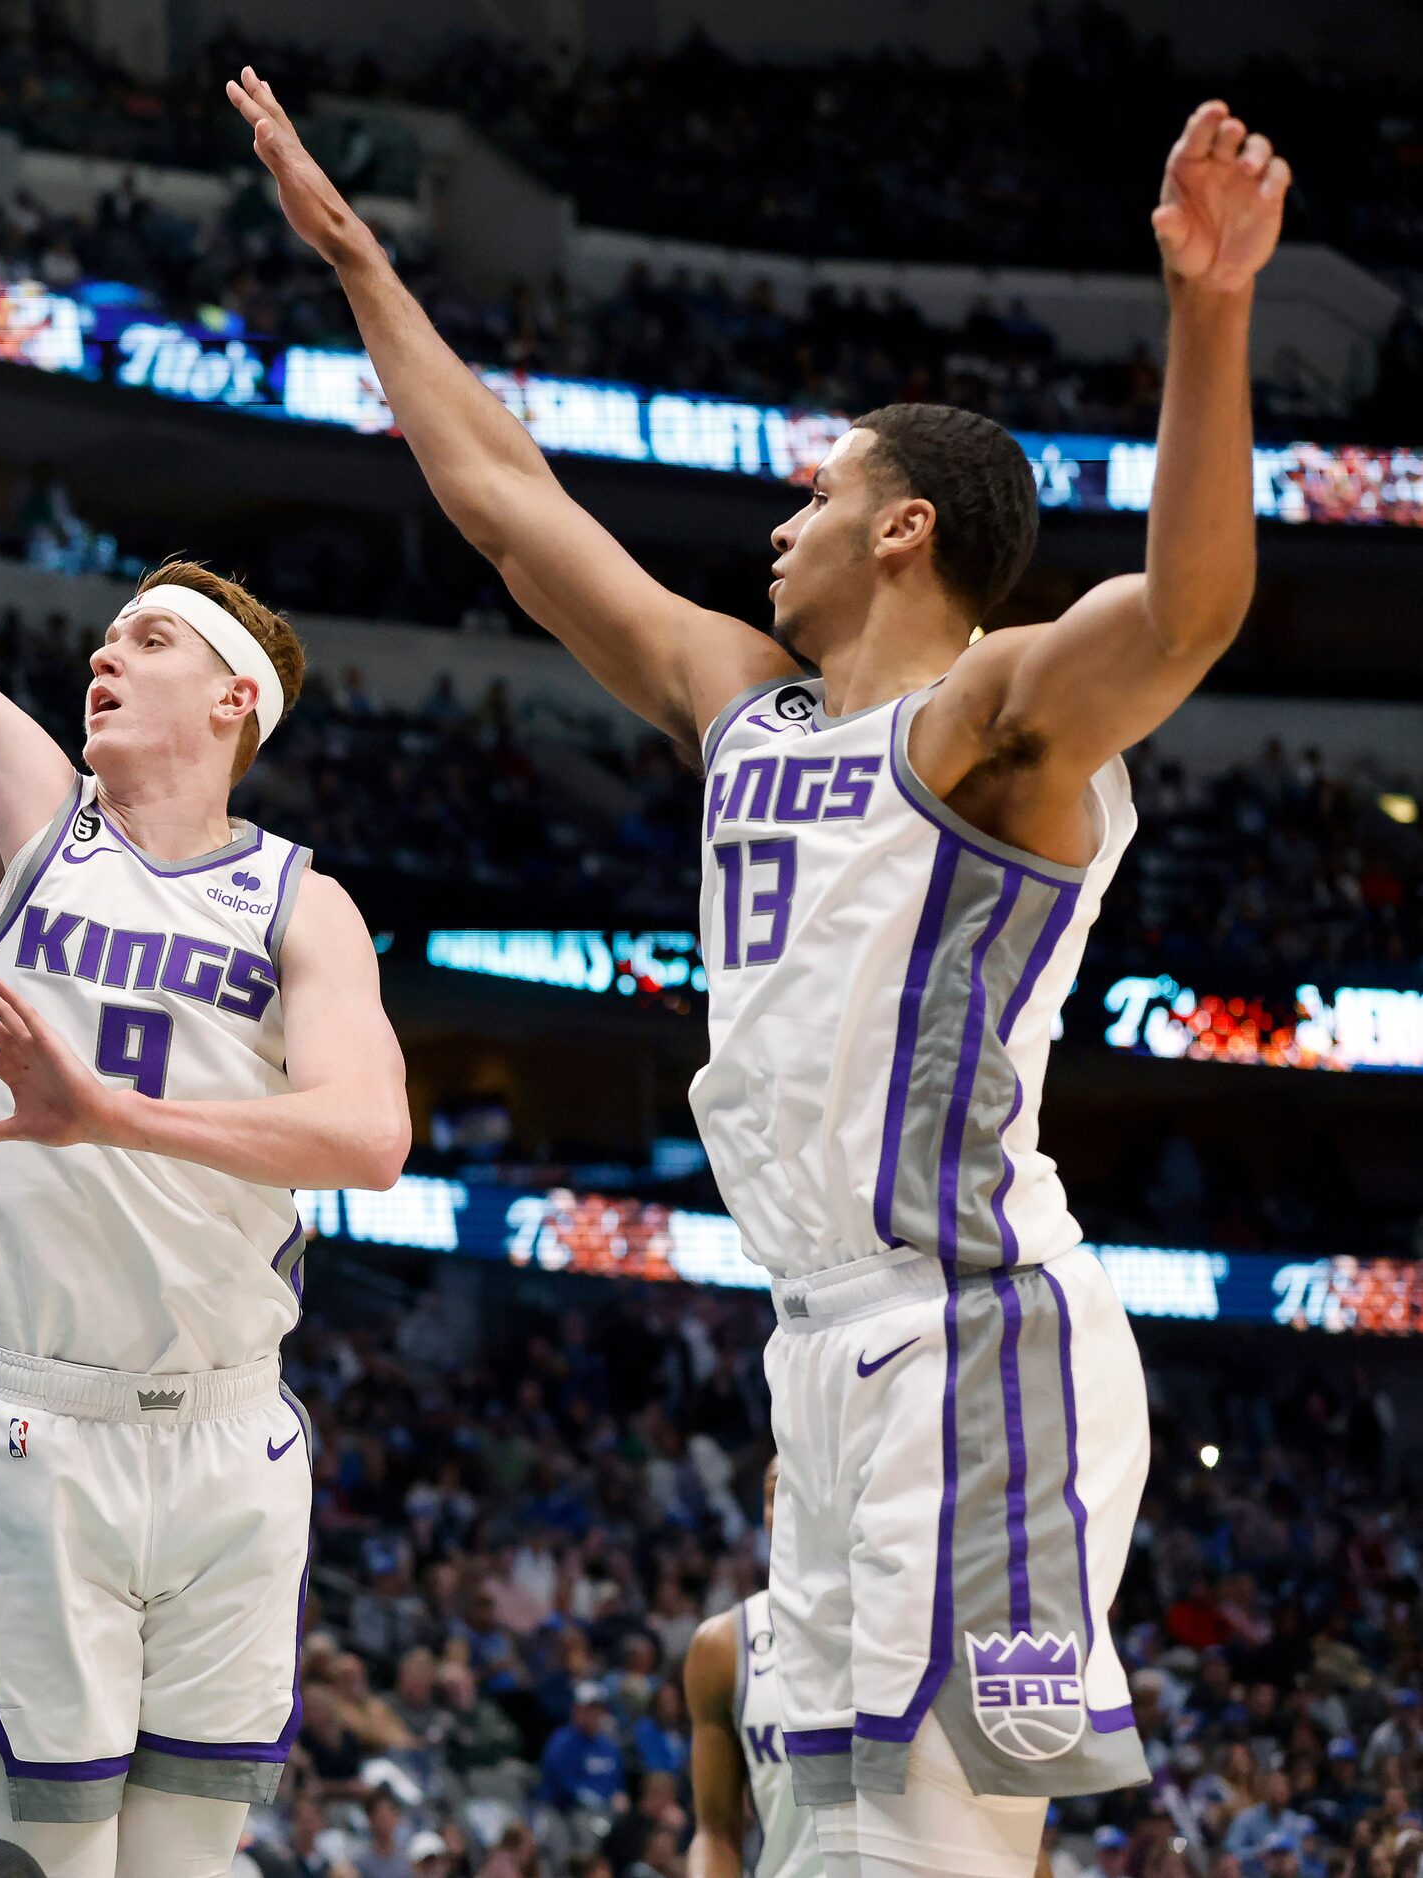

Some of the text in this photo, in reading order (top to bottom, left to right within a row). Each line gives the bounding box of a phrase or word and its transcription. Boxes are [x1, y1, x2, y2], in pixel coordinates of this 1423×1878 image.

[119, 322, 263, 404] Tito's
[780, 694, 814, 721] 6
[706, 754, 885, 842] NGS
[206, 887, 273, 917] dialpad
[712, 835, 798, 970] 13
[14, 905, 279, 1022] KINGS
[95, 1003, 174, 1100] 9
[977, 1679, 1080, 1707] SAC
